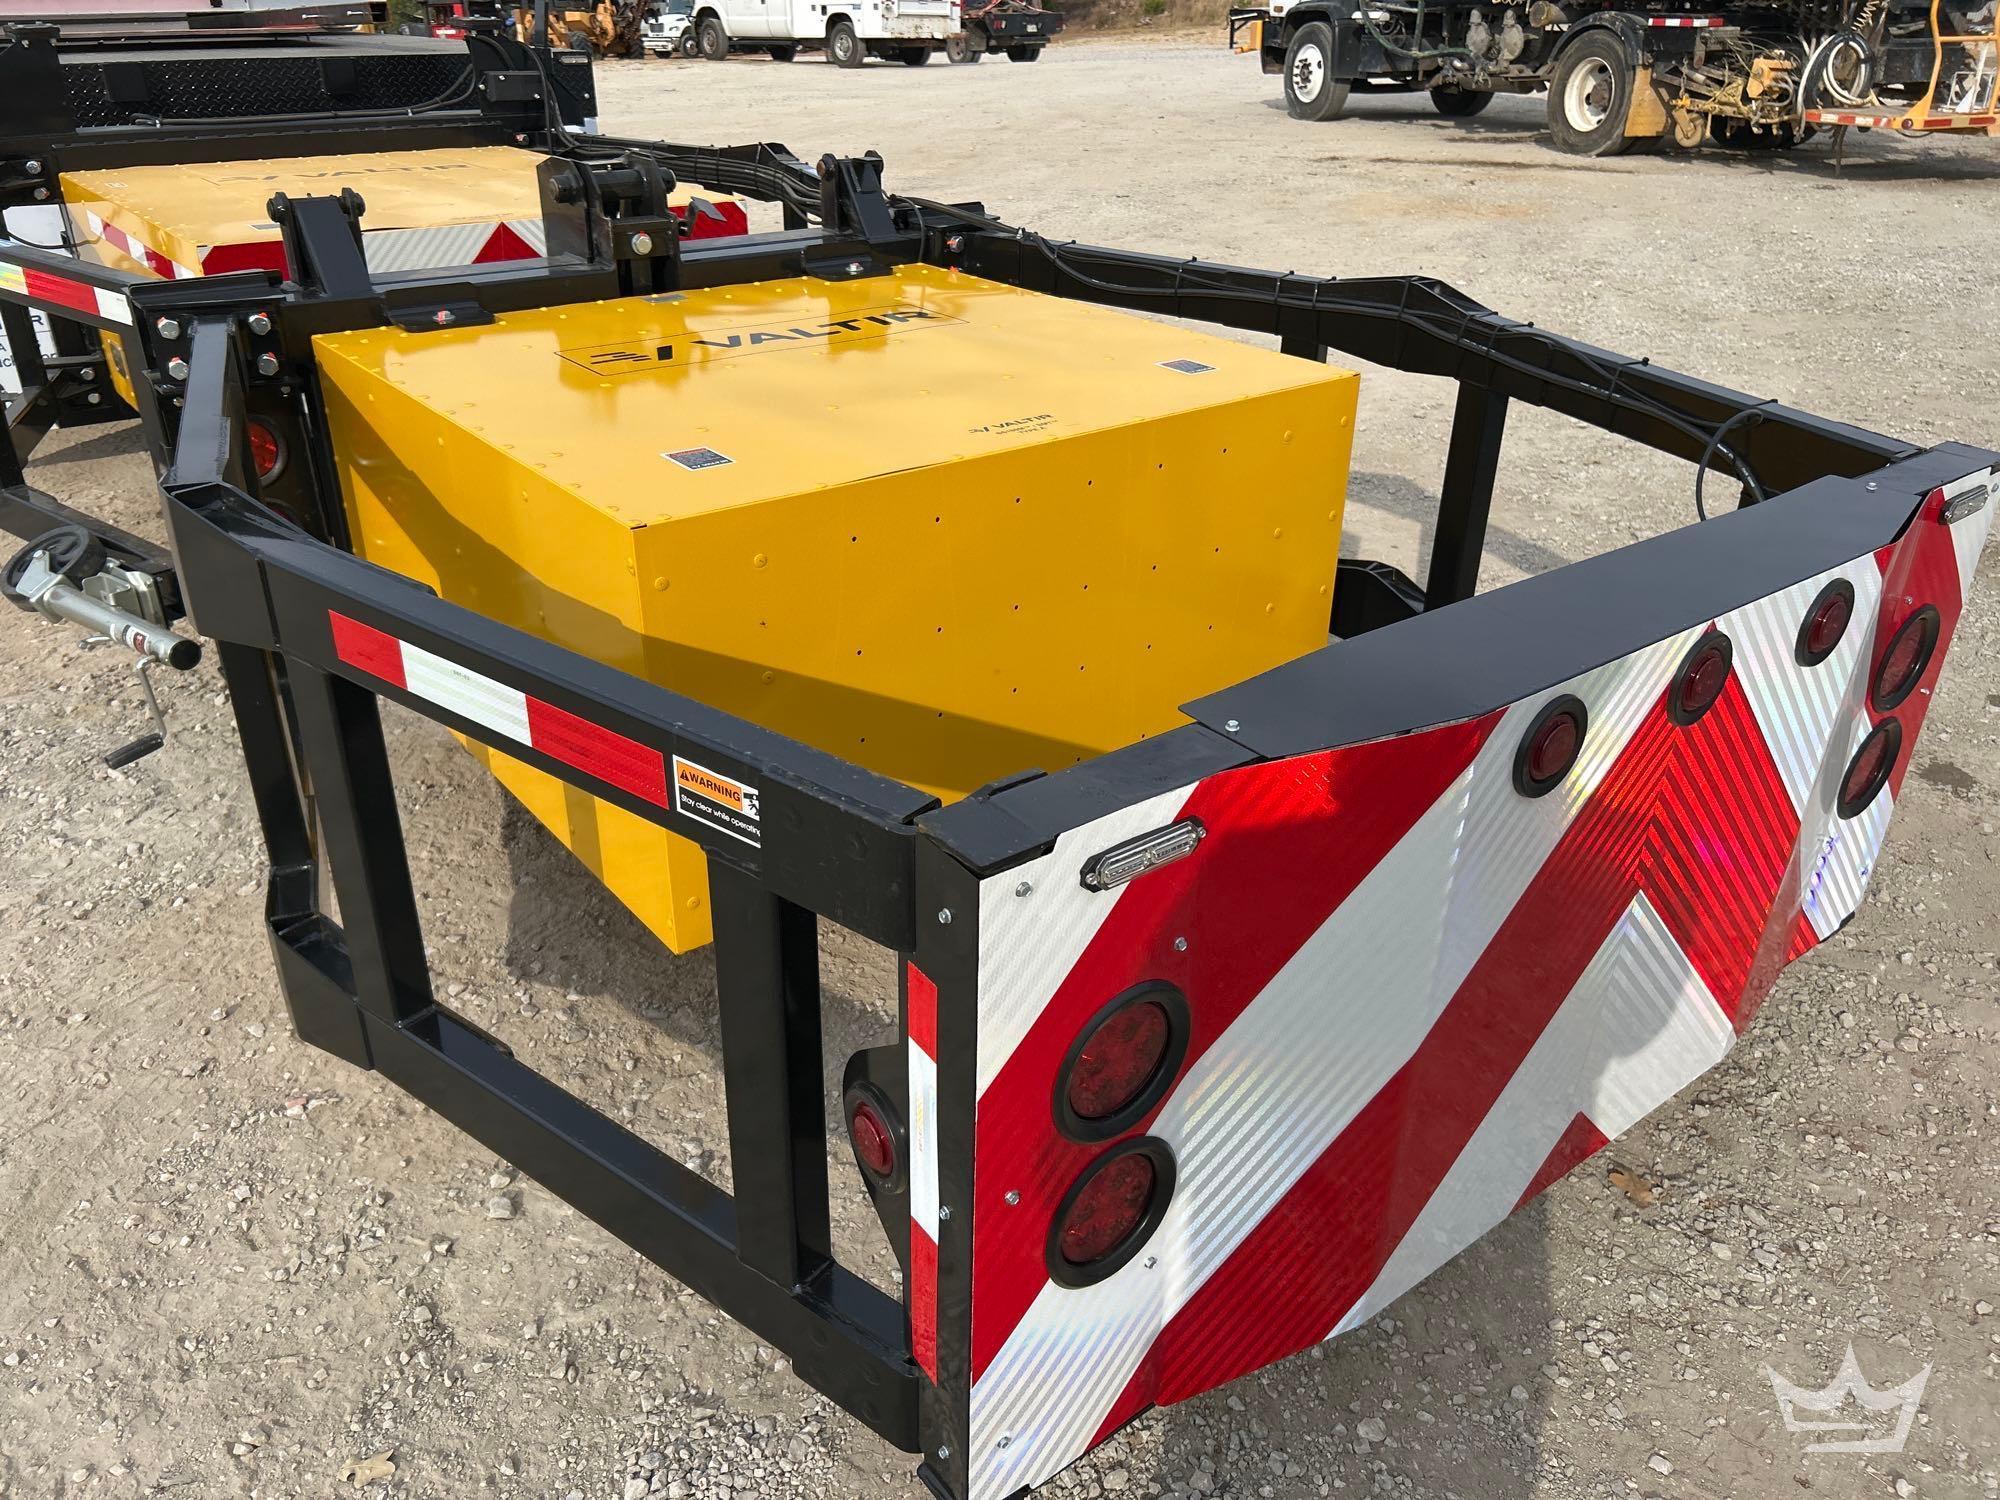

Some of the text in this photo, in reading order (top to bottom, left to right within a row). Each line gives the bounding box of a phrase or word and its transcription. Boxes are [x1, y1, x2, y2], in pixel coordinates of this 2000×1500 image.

[690, 311, 942, 348] VALTIR
[991, 414, 1053, 428] VALTIR
[689, 772, 741, 802] WARNING
[695, 802, 713, 813] clear
[713, 809, 730, 822] while
